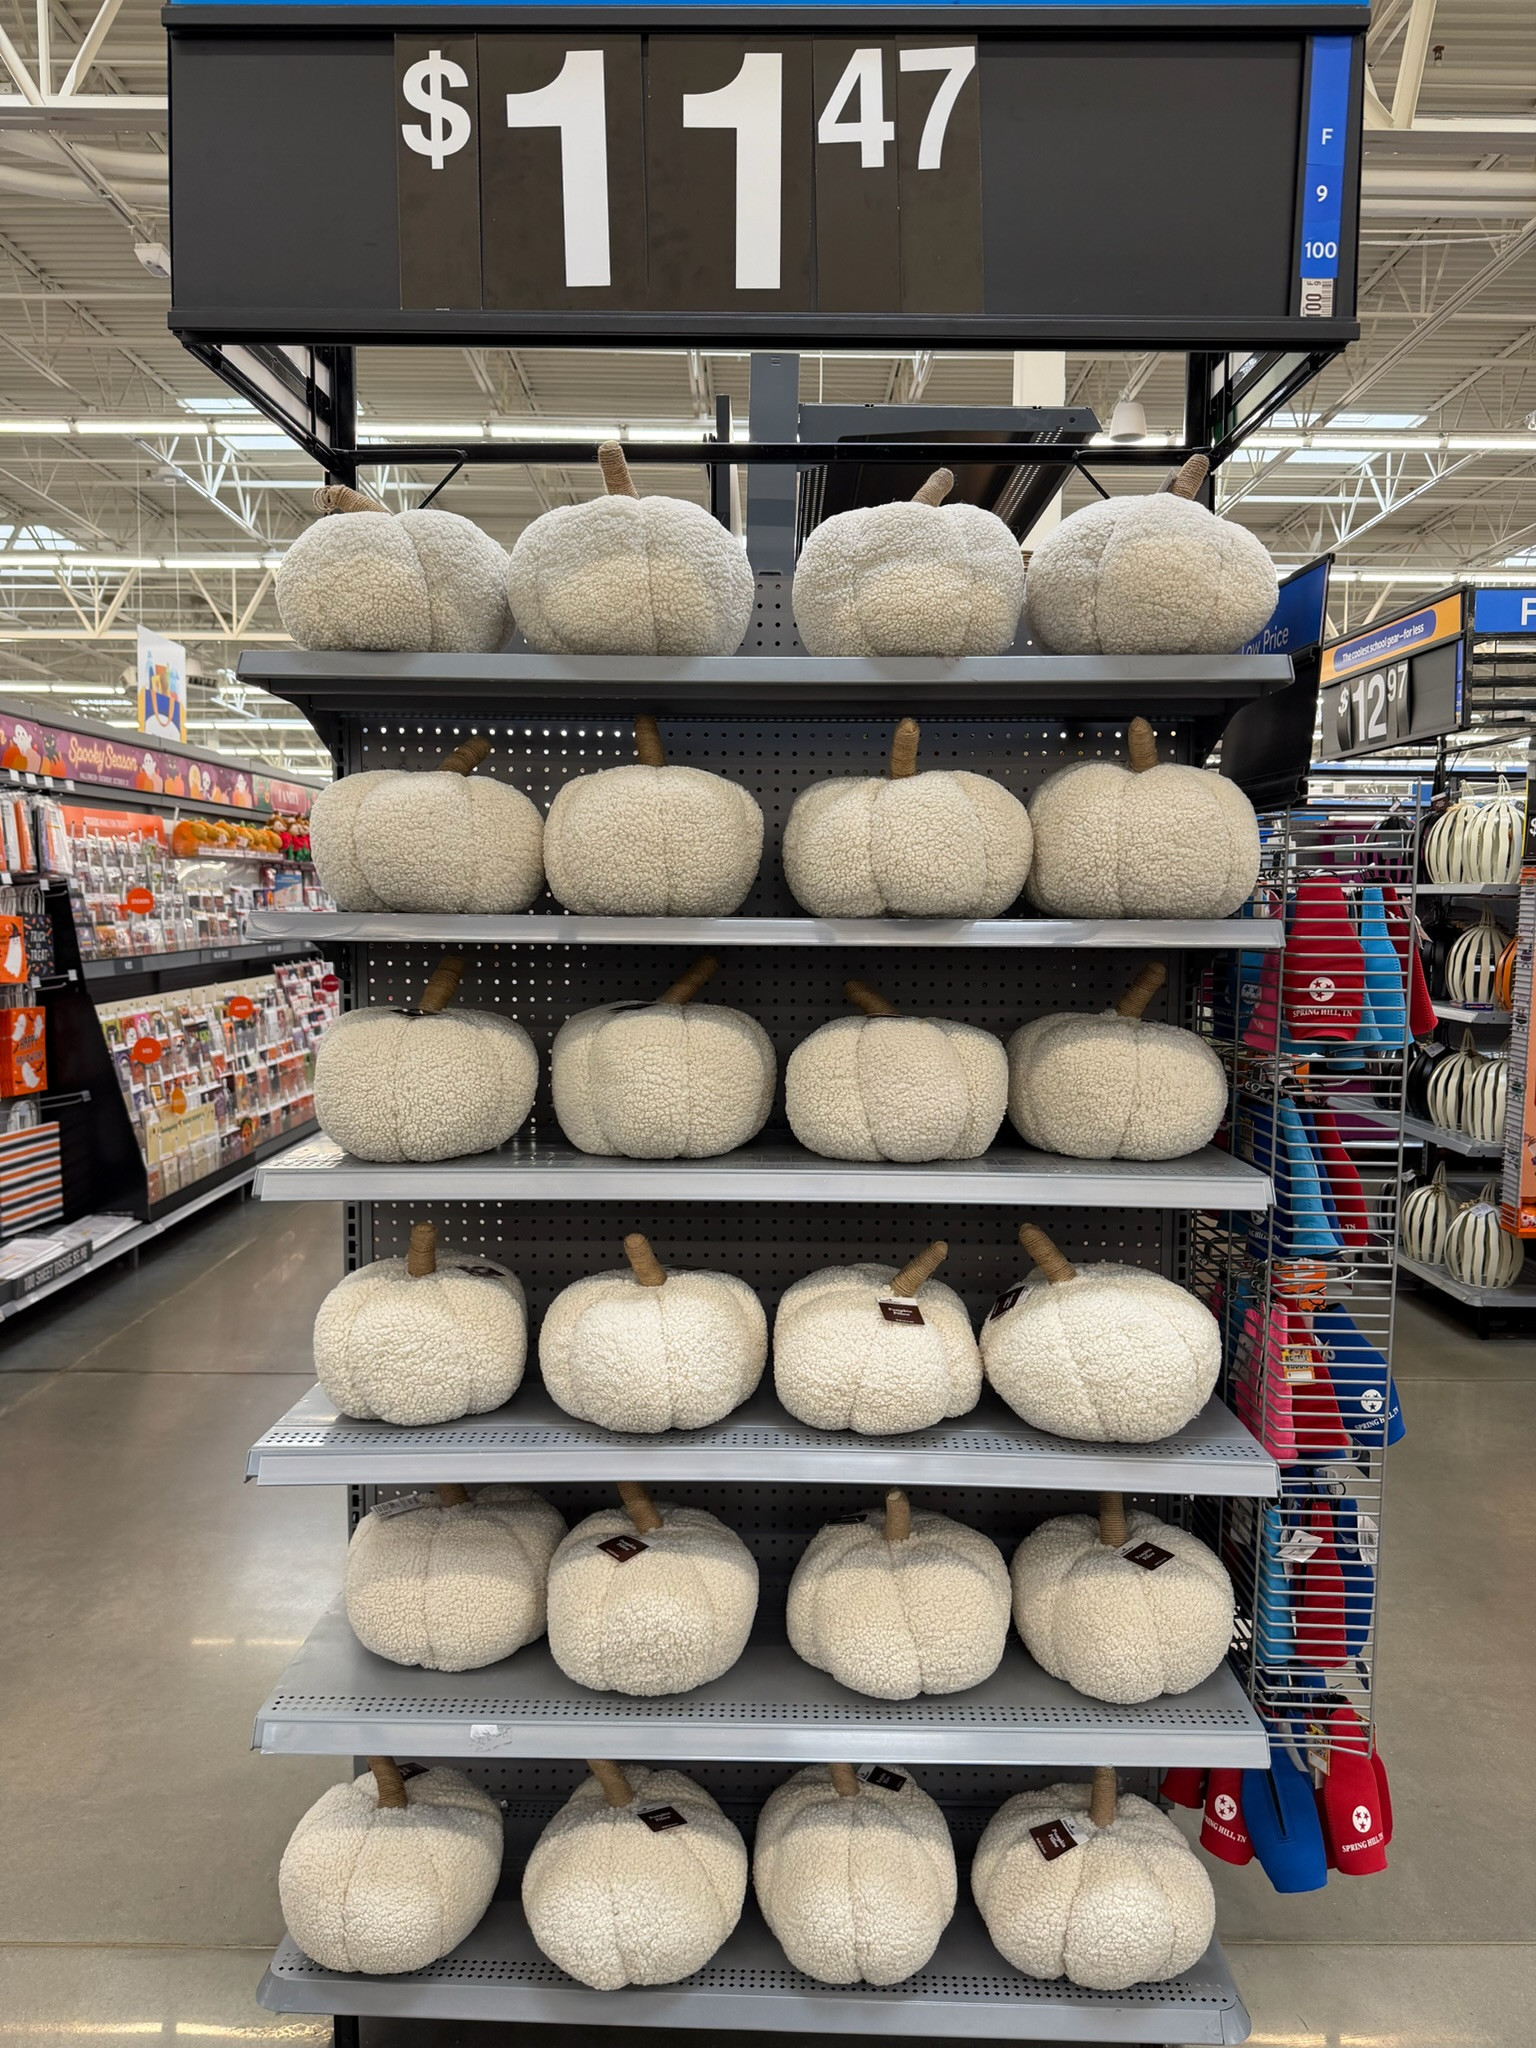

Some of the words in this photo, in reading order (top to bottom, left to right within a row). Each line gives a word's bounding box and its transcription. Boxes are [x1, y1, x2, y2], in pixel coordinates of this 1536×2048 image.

[1321, 128, 1334, 145] F
[1316, 184, 1329, 203] 9
[1304, 241, 1338, 259] 100
[1263, 625, 1289, 655] Price
[1342, 652, 1352, 663] The
[1351, 645, 1370, 660] coolest
[1369, 637, 1387, 653] school
[1412, 623, 1425, 636] less
[68, 735, 105, 773] Spooky
[104, 743, 138, 772] Season
[1292, 1008, 1320, 1018] SPRING
[1320, 1008, 1341, 1018] HILL,
[1342, 1009, 1353, 1017] TN
[1354, 1418, 1380, 1430] SPRING
[1219, 1826, 1236, 1841] HILL,
[1236, 1834, 1248, 1844] TN
[1342, 1840, 1368, 1853] SPRING
